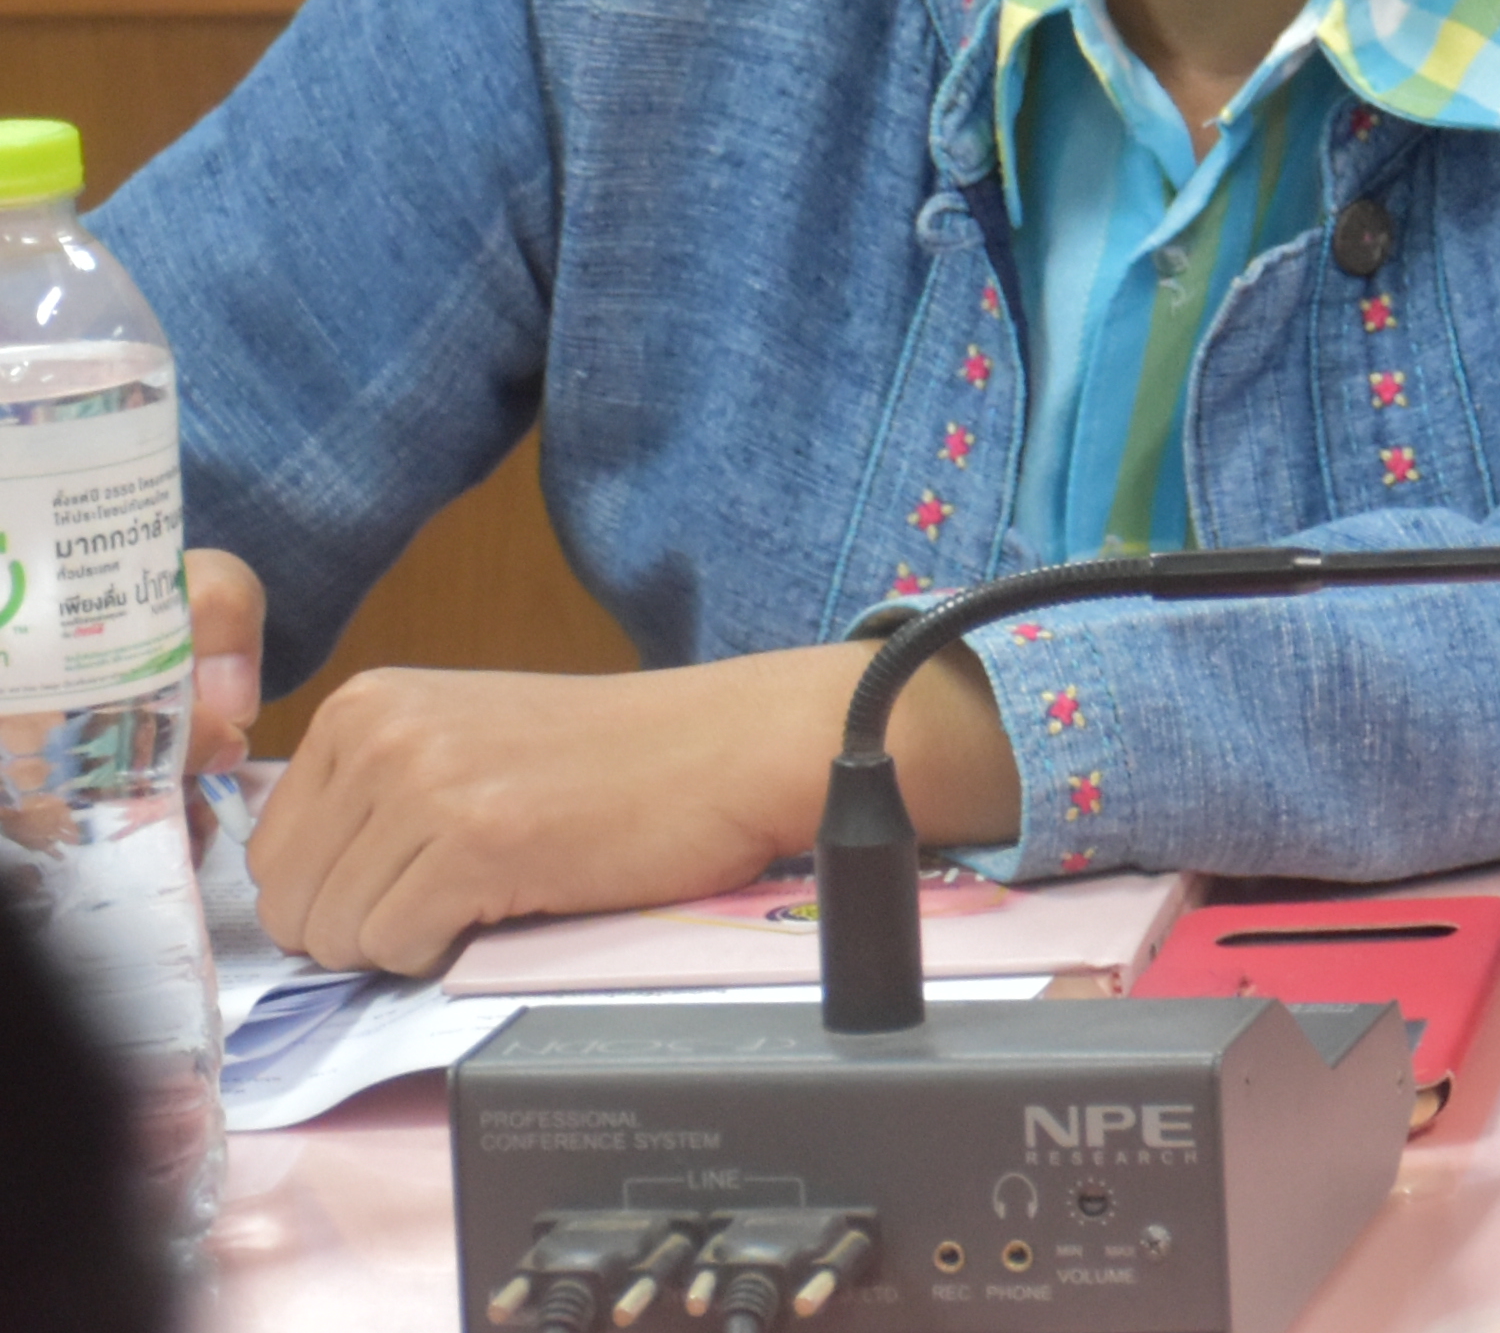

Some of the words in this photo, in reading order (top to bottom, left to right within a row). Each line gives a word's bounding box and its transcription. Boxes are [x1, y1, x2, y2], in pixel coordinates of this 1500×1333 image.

[480, 1110, 642, 1129] PROFESSIONAL
[1025, 1105, 1197, 1148] NPE
[480, 1131, 627, 1151] CONFERENCE
[633, 1131, 723, 1150] SYSTEM
[1025, 1150, 1199, 1166] RESEARCH
[687, 1169, 742, 1190] LINE
[1056, 1267, 1138, 1285] VOLUME
[931, 1284, 972, 1301] REC
[985, 1284, 1053, 1301] PHONE
